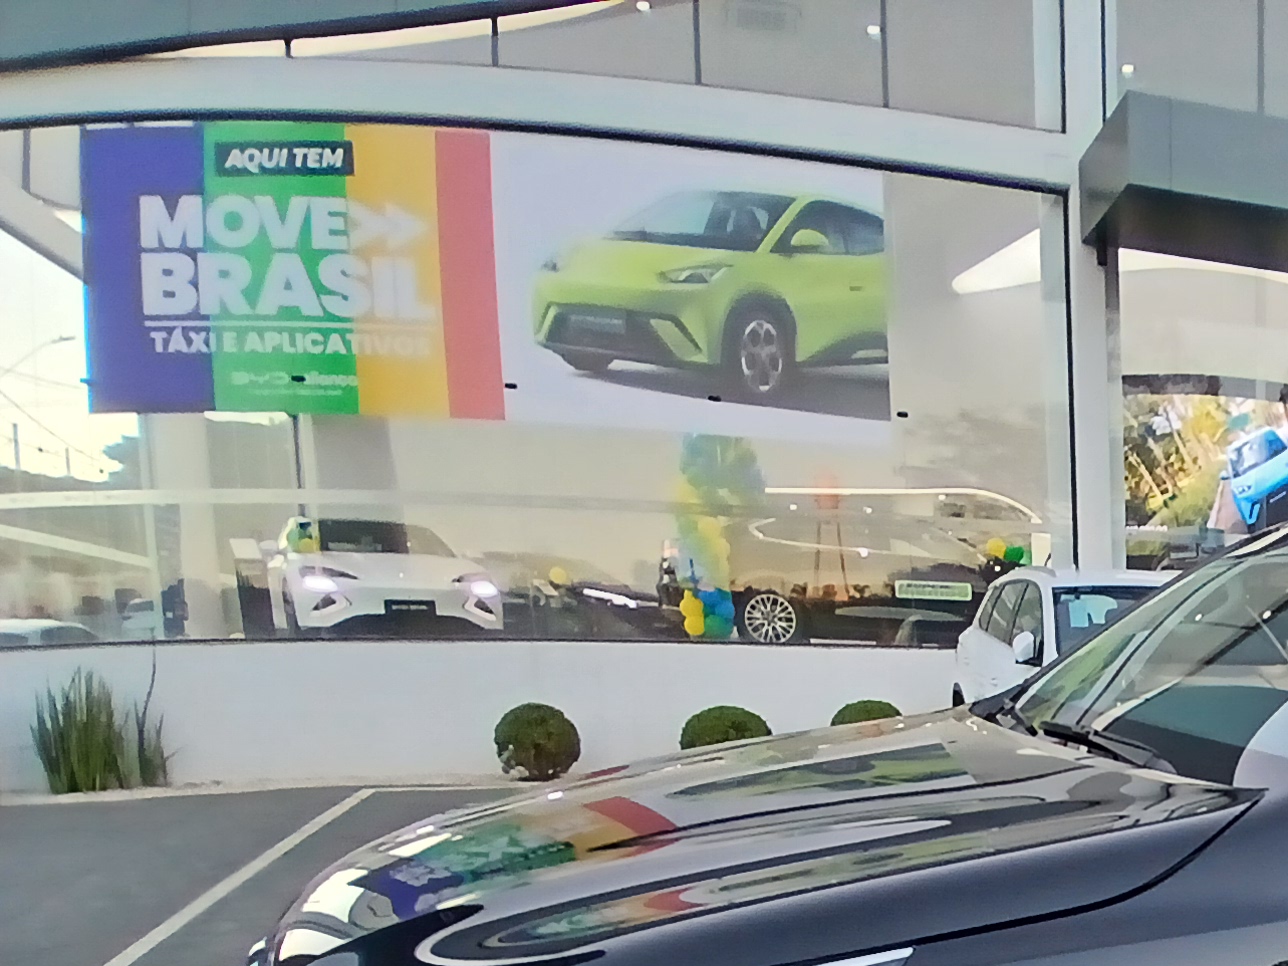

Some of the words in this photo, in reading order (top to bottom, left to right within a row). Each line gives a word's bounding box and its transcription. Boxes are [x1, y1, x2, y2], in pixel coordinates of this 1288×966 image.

[224, 147, 288, 173] AQUI
[293, 147, 344, 168] TEM
[138, 194, 349, 251] MOVE
[140, 251, 435, 317] BRASIL
[150, 325, 216, 353] TÁXI
[222, 331, 238, 352] E
